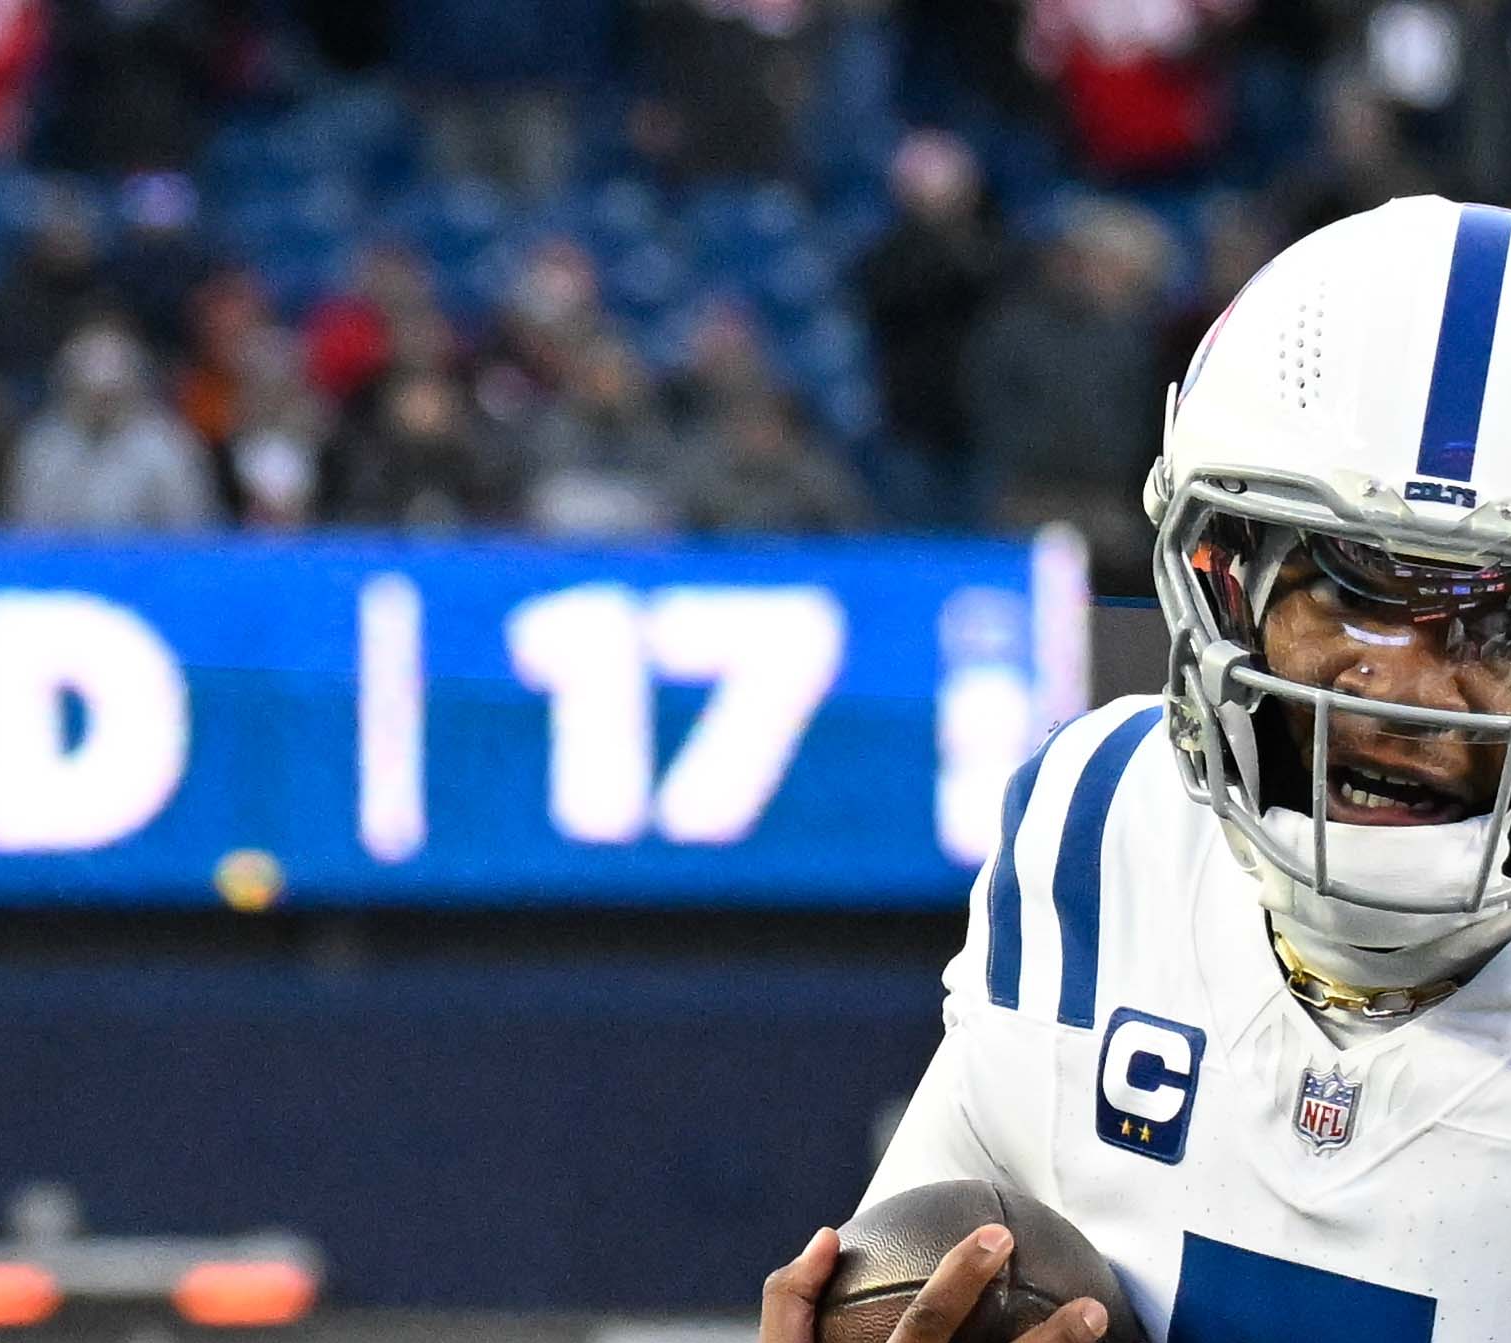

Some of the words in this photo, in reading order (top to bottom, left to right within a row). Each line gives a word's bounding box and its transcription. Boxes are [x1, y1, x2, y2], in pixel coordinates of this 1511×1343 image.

[1404, 481, 1477, 509] COLTS
[503, 582, 847, 844] 17
[1102, 1019, 1192, 1123] C
[1300, 1099, 1344, 1138] NFL
